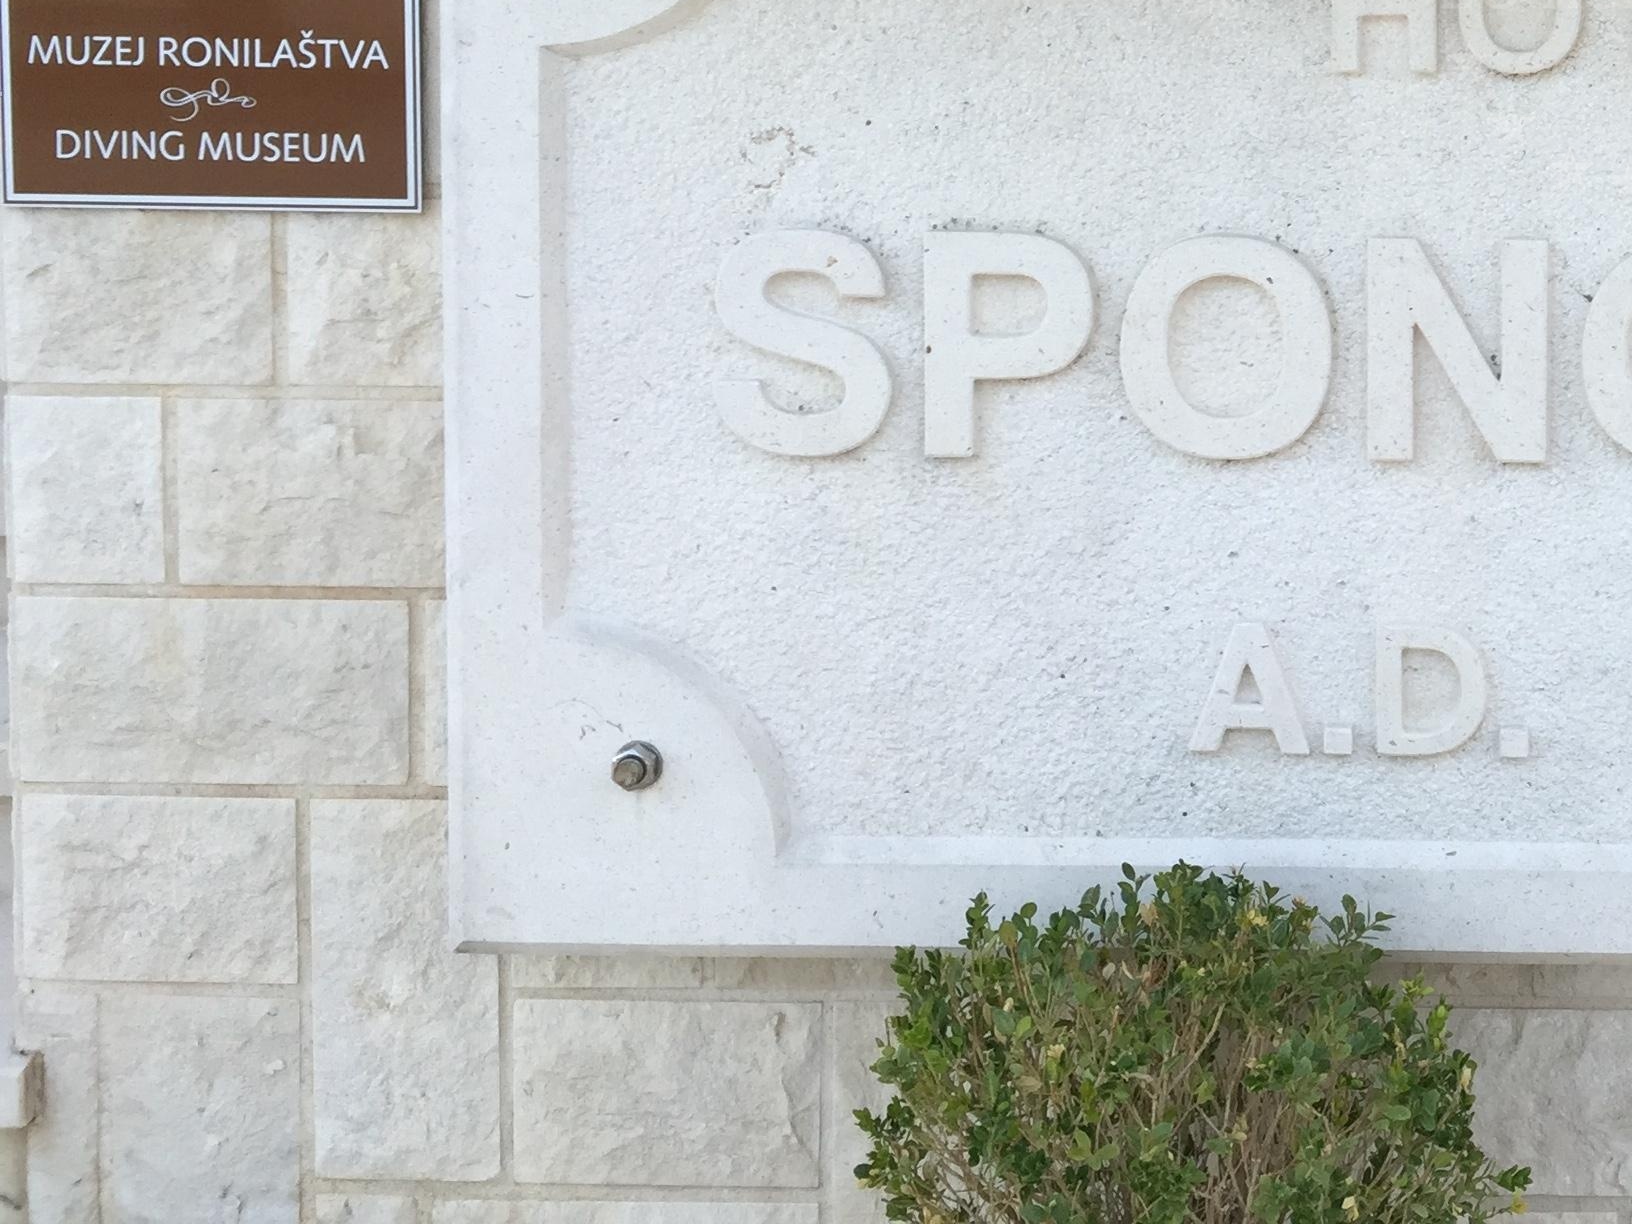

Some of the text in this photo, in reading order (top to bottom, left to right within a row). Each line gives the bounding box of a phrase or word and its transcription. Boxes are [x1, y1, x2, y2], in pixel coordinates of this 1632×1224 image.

[28, 28, 390, 70] MUZEJ RONILAŠTVA
[55, 129, 366, 163] DIVING MUSEUM
[1187, 622, 1531, 759] A.D.
